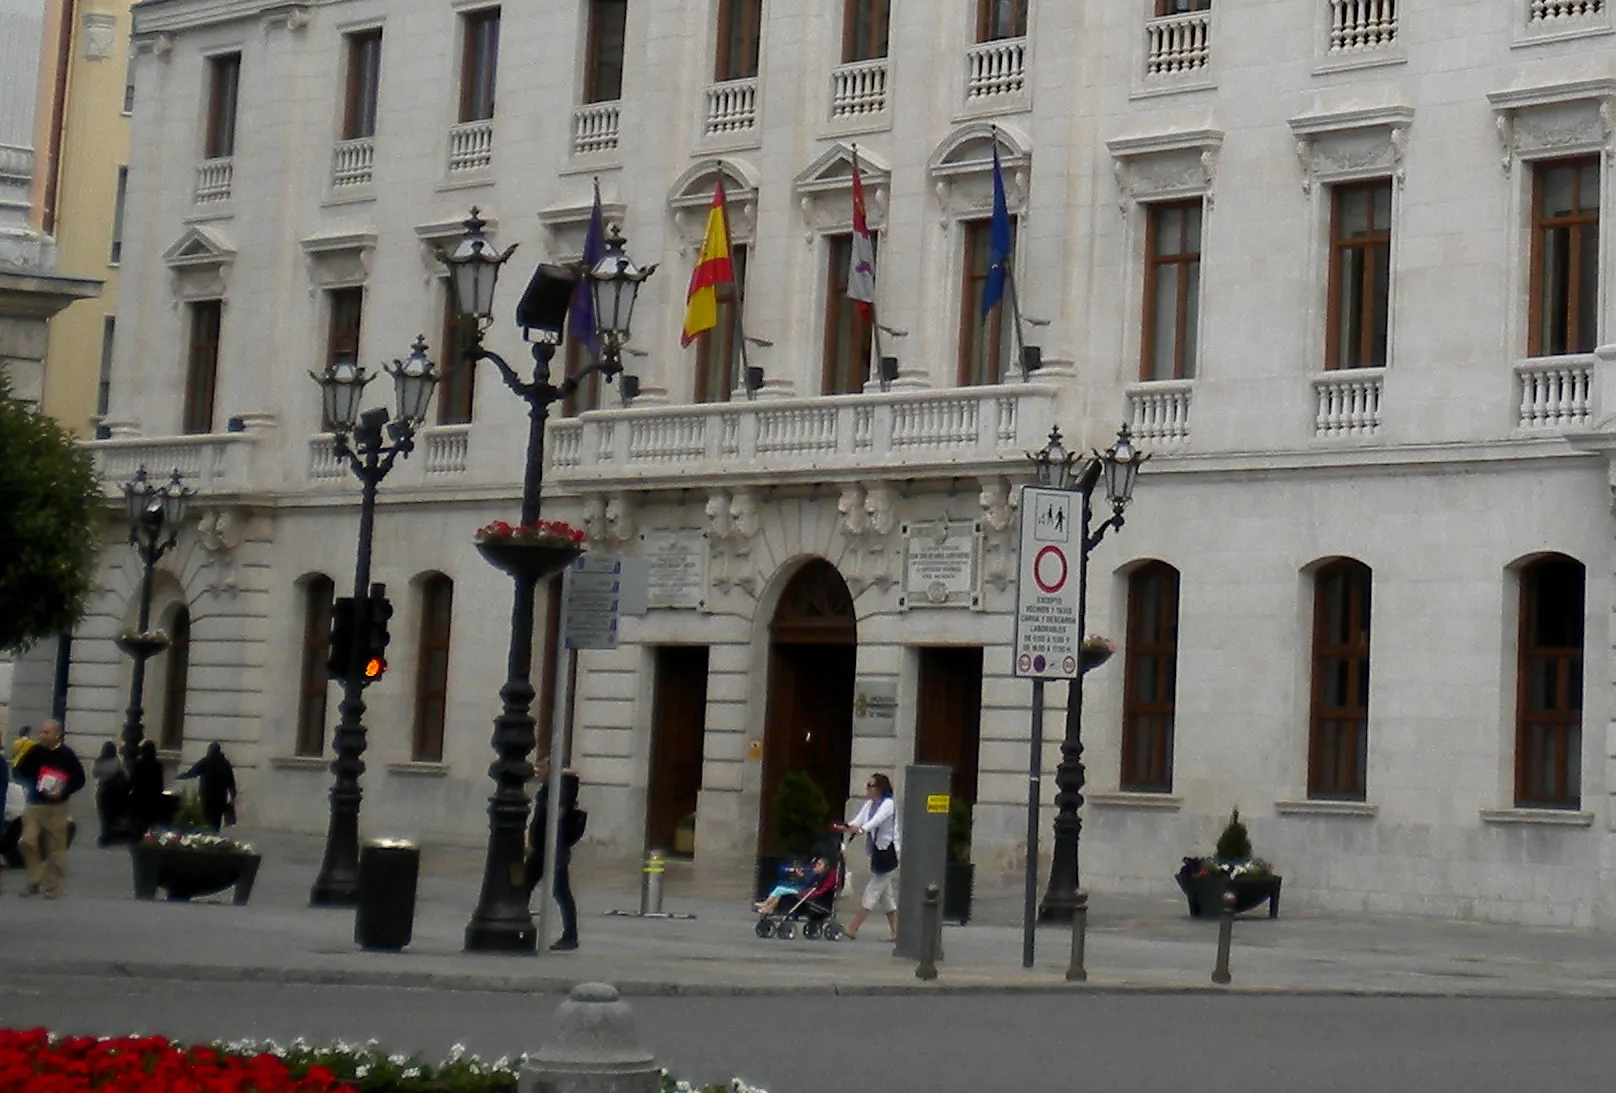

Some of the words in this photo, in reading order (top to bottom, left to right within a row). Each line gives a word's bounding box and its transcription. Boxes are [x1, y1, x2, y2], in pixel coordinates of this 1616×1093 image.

[1036, 596, 1062, 605] EXCEPTO
[1020, 614, 1039, 623] CARGA
[1046, 616, 1076, 624] DESCARGA
[1030, 625, 1067, 633] LABORABLES
